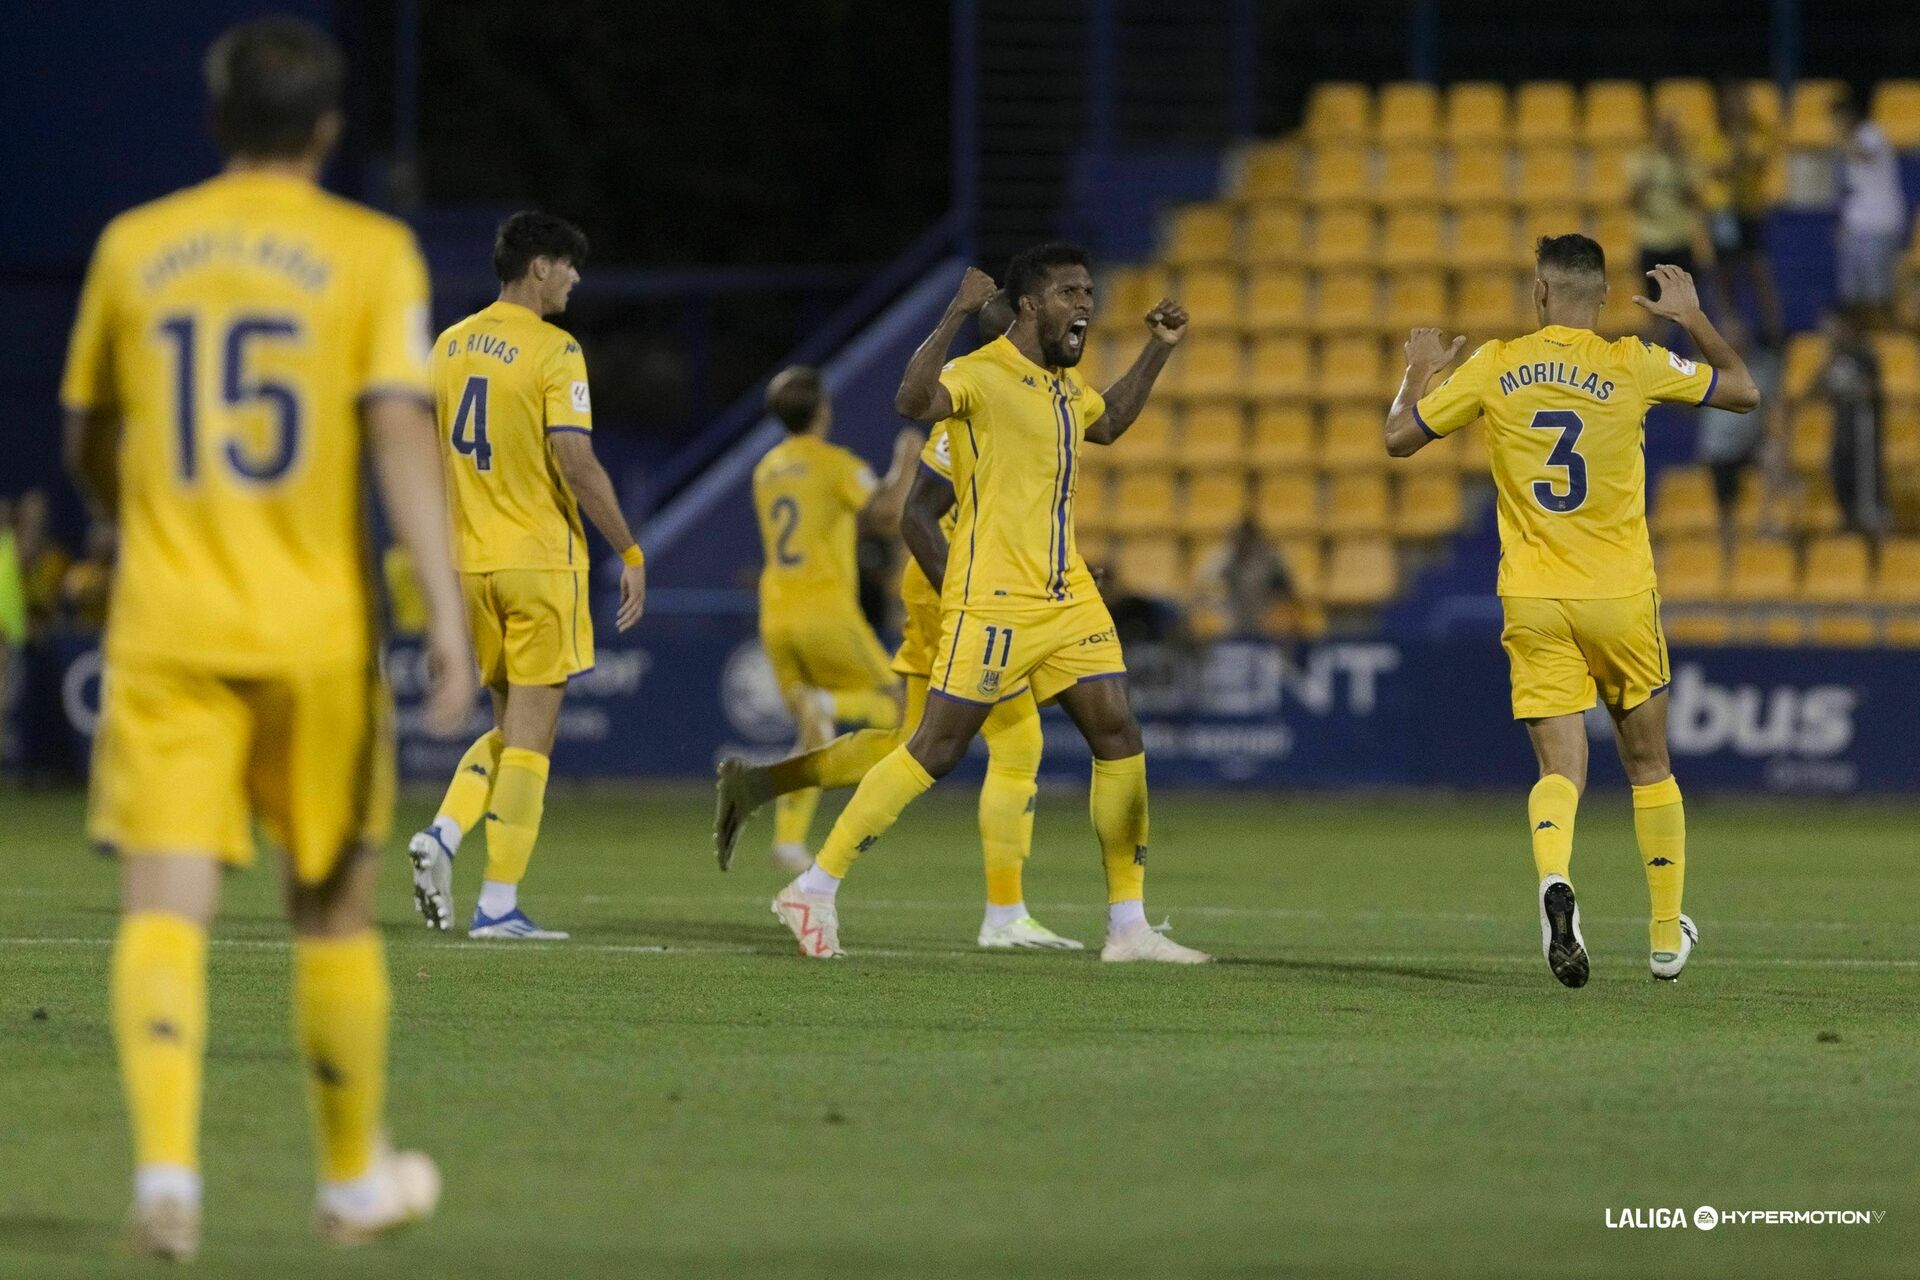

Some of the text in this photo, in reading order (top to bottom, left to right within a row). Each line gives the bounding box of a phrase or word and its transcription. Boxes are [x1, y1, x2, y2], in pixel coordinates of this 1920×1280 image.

[467, 333, 519, 365] RIVAS
[1499, 361, 1615, 401] MORILLAS
[160, 316, 301, 482] 15
[452, 376, 492, 471] 4
[1530, 410, 1588, 513] 3
[769, 494, 805, 568] 2
[982, 626, 1013, 667] 11
[1585, 662, 1858, 758] bus
